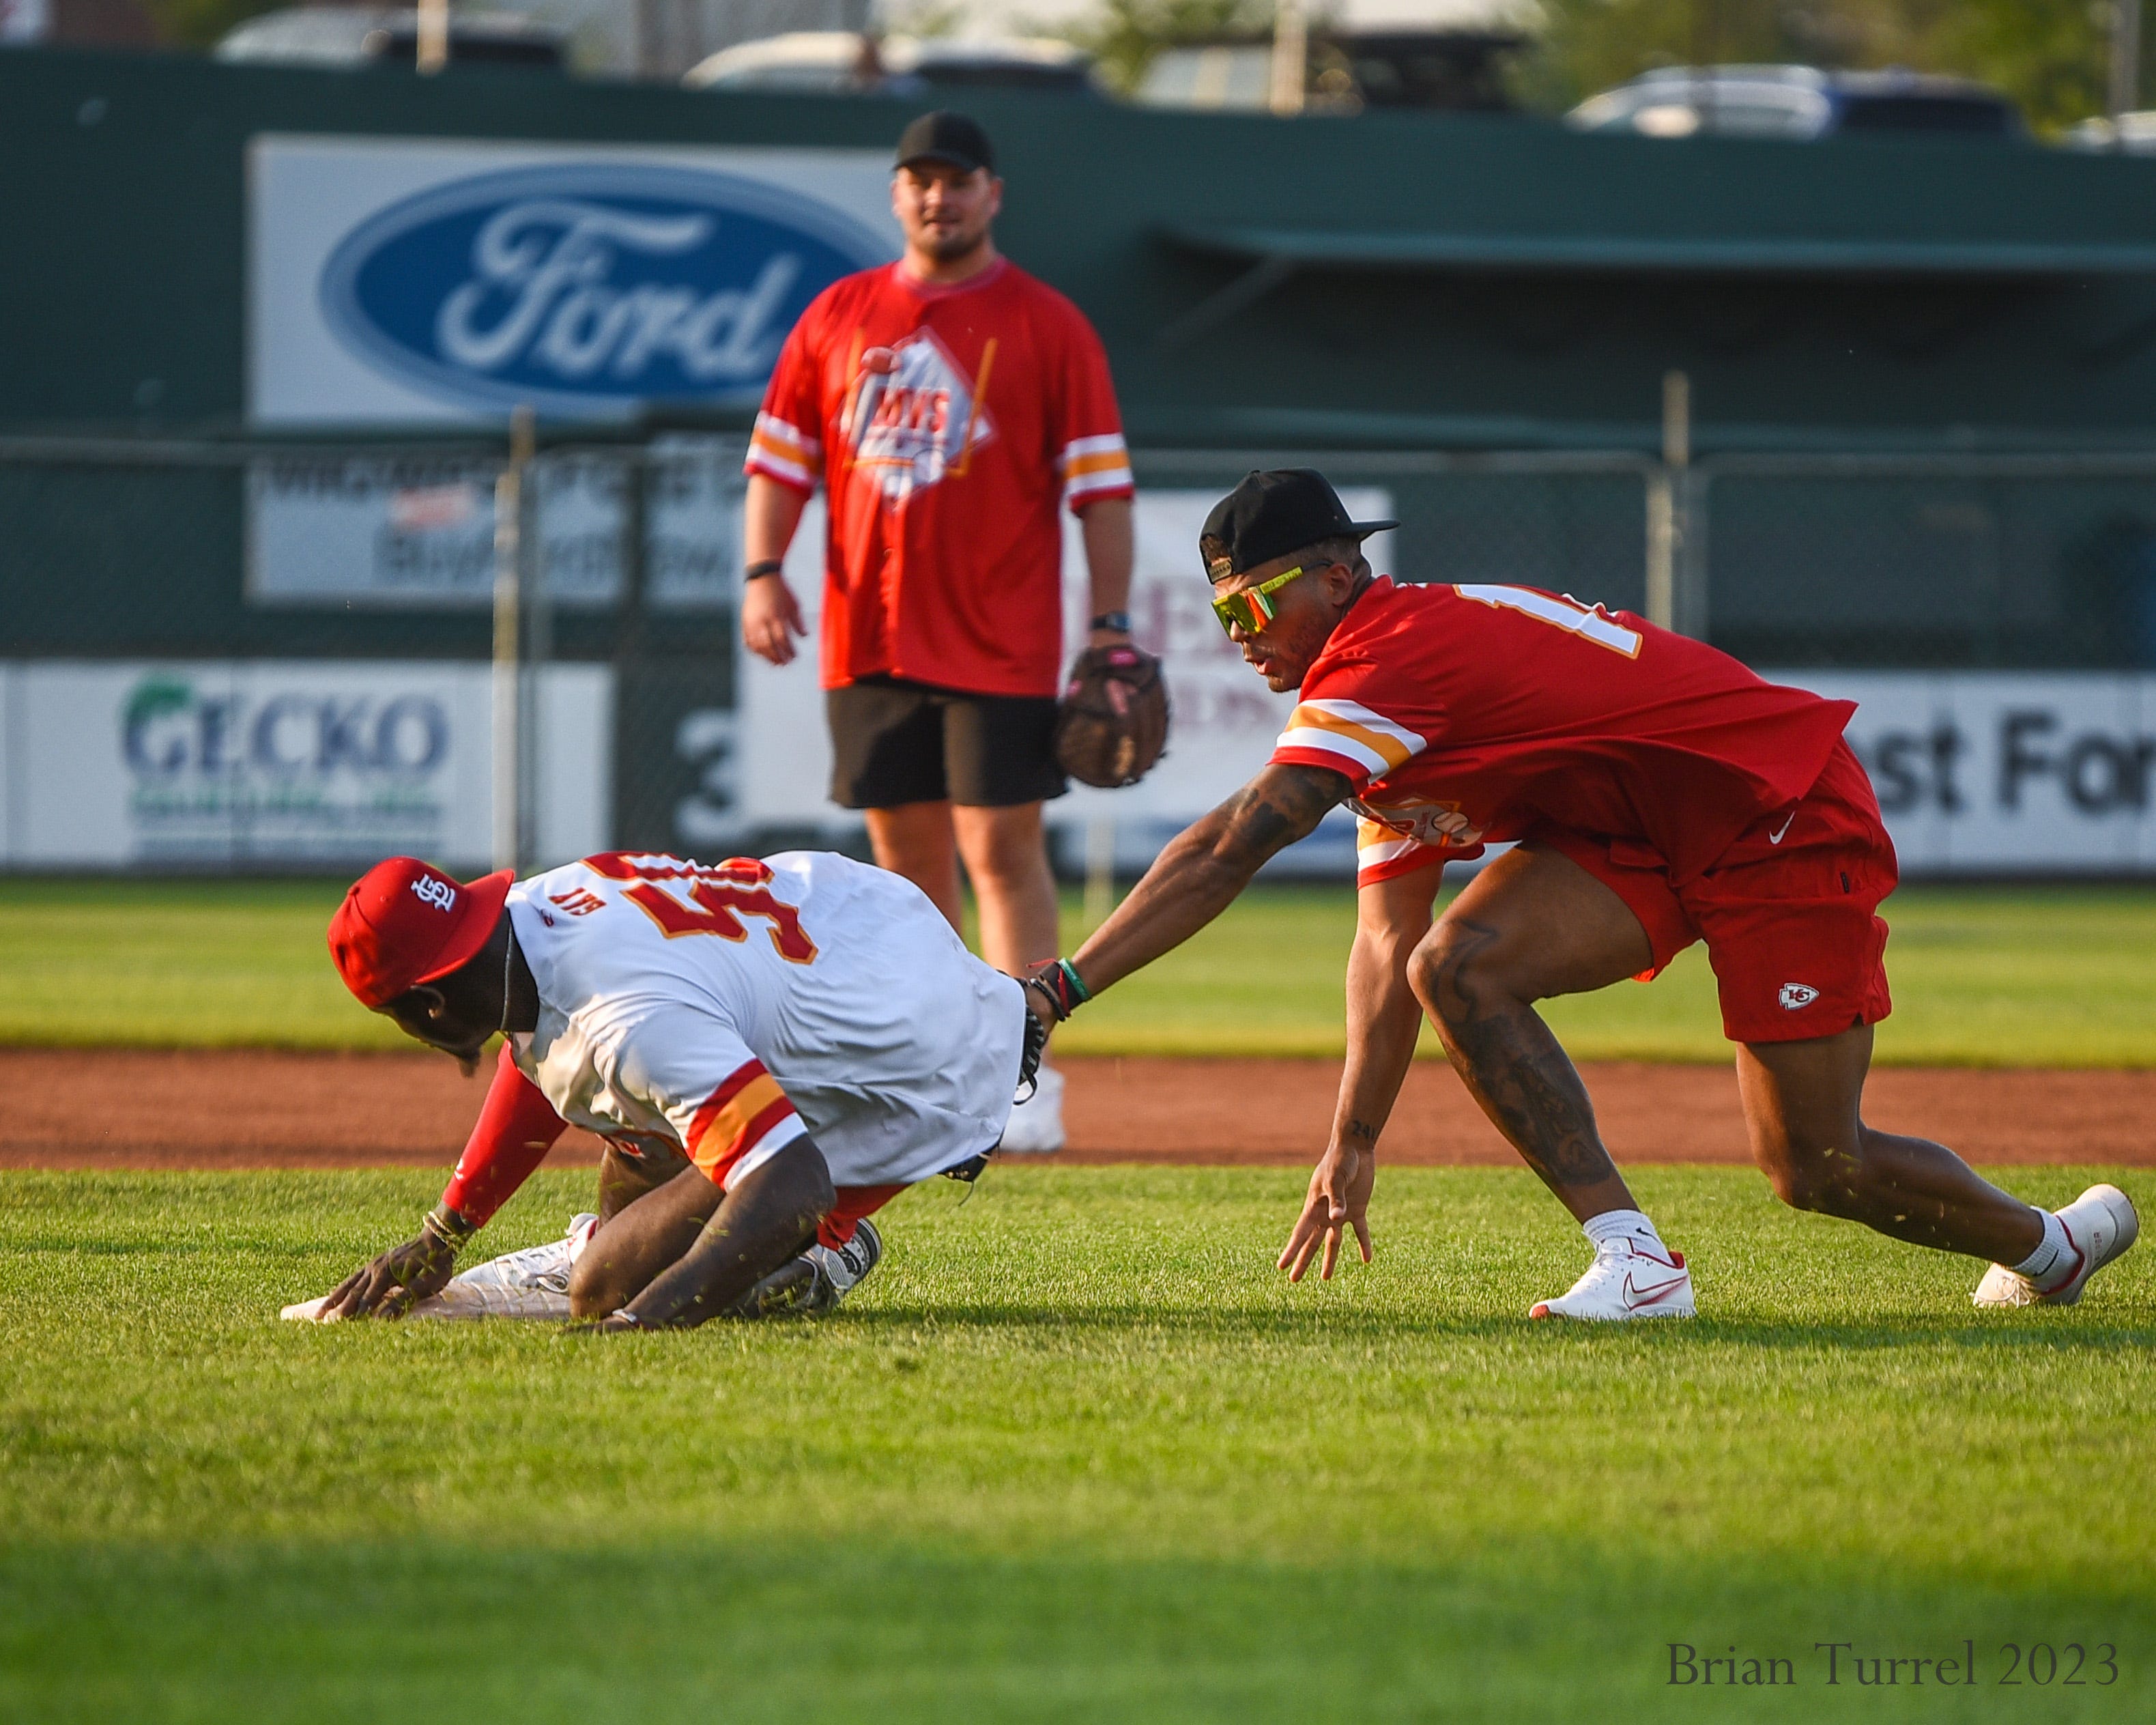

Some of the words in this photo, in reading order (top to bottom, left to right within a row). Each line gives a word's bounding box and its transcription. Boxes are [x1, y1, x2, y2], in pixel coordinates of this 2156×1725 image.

[434, 198, 803, 380] Ford
[123, 676, 450, 778] GECKO
[1858, 707, 1968, 815] st
[1788, 988, 1810, 1003] KC
